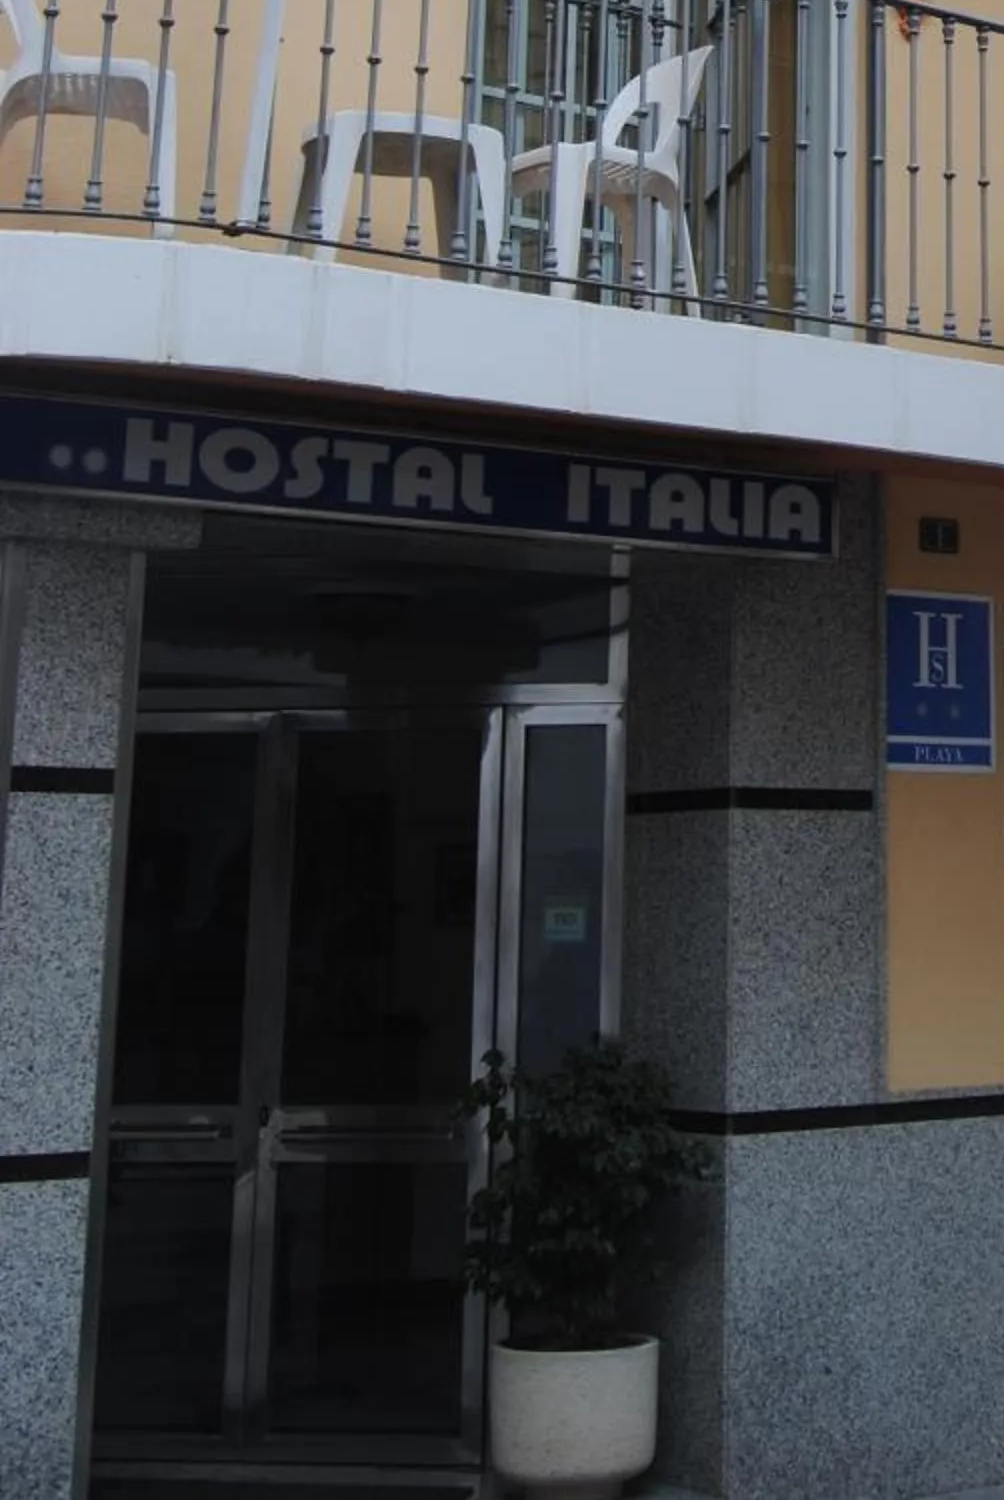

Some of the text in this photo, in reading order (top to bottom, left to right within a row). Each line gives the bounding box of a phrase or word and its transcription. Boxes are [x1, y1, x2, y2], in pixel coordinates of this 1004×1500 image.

[122, 417, 822, 544] HOSTAL ITALIA
[913, 745, 964, 764] PLAYA
